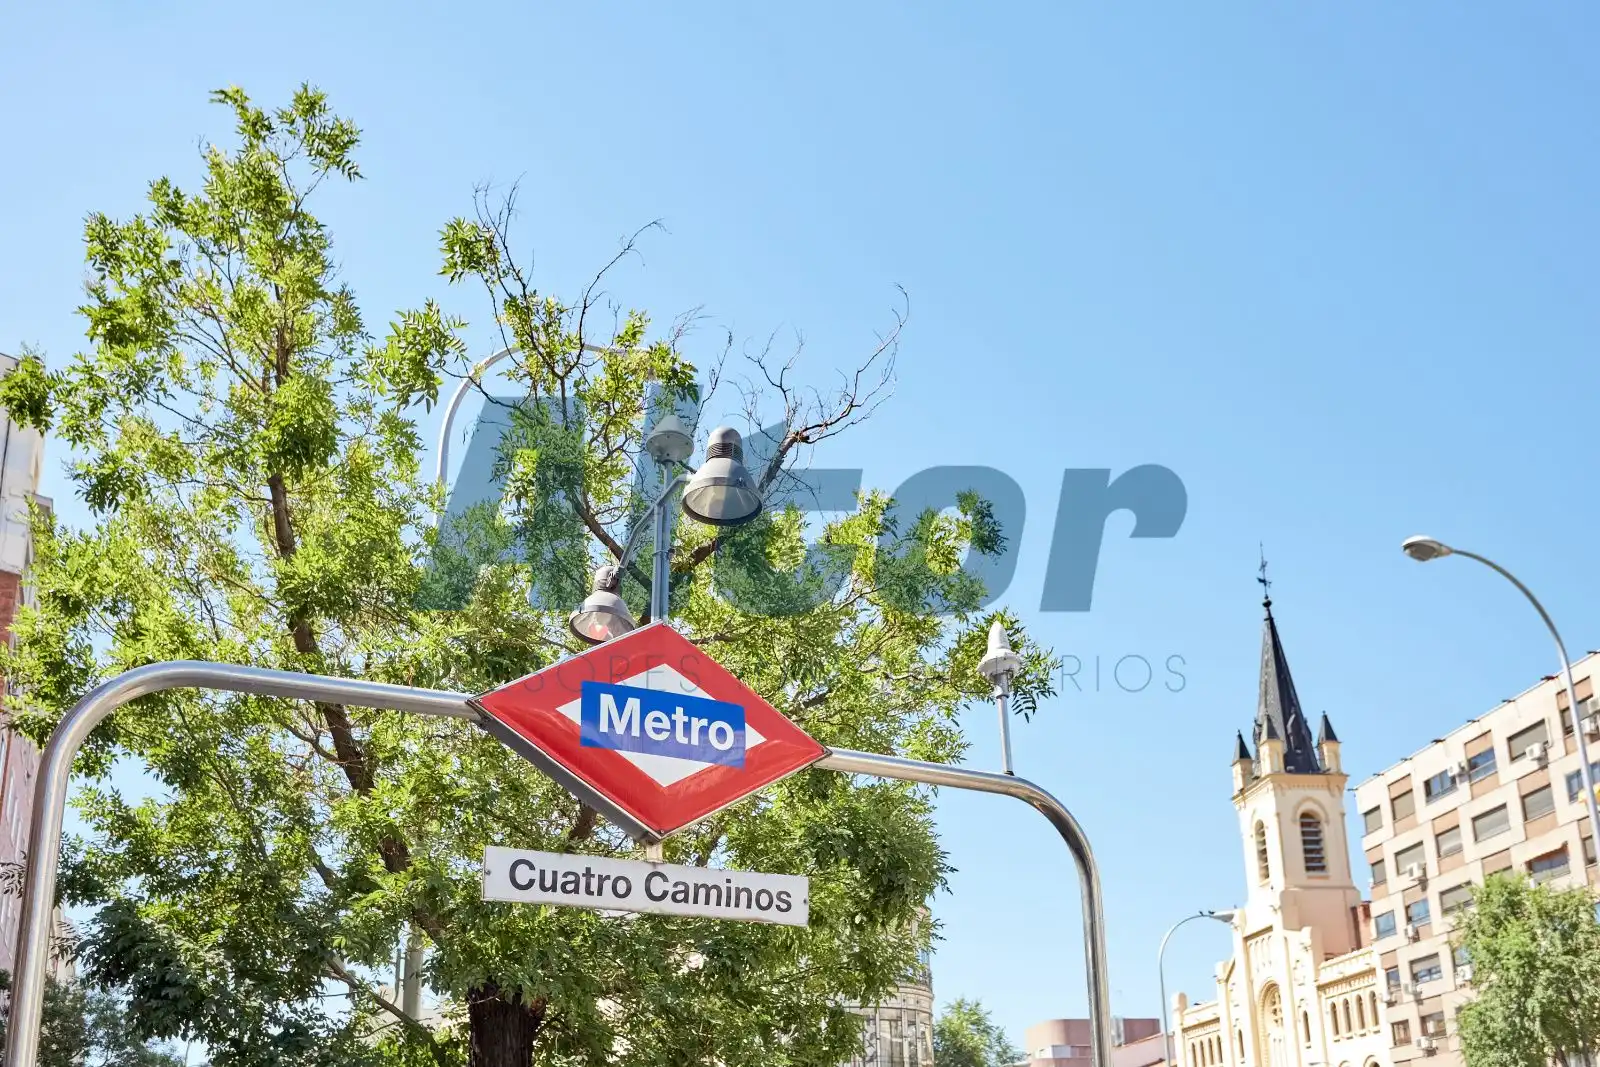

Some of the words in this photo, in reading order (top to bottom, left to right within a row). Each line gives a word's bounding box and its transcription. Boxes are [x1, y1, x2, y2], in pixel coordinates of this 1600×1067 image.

[599, 693, 735, 752] Metro
[508, 858, 633, 899] Cuatro
[644, 870, 793, 913] Caminos
